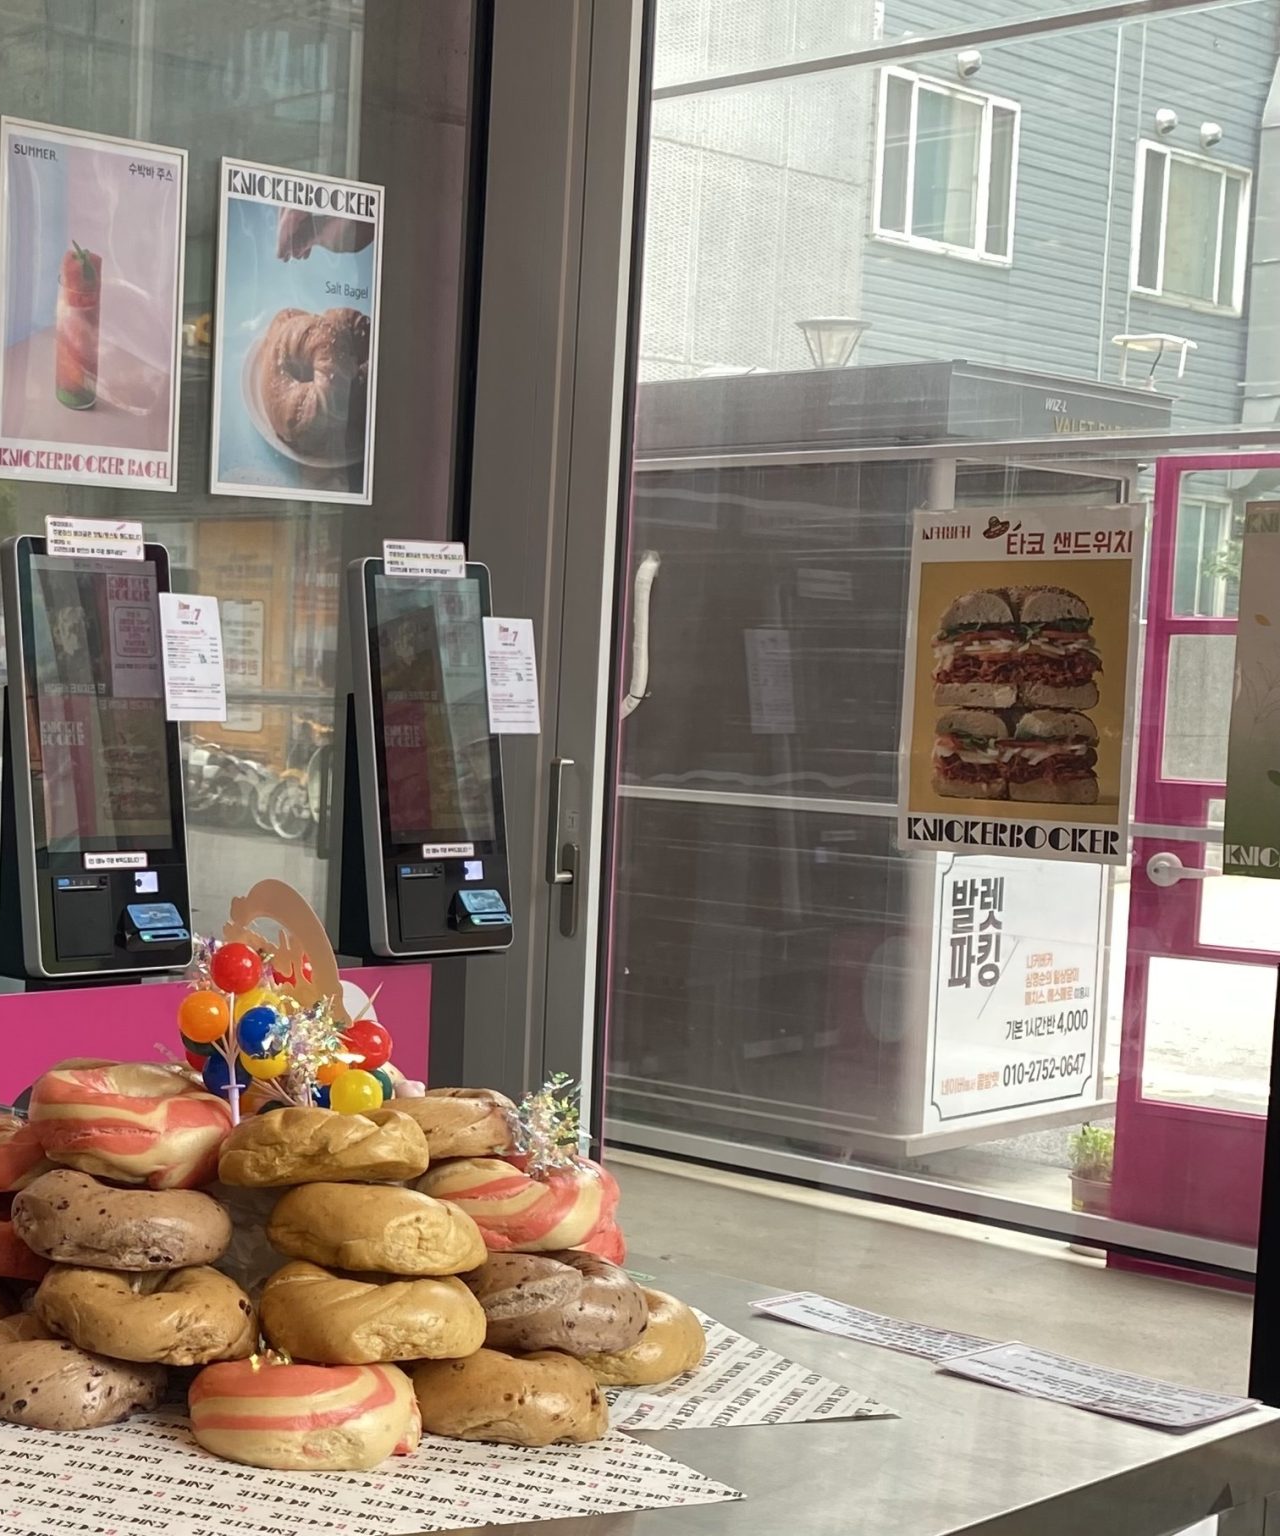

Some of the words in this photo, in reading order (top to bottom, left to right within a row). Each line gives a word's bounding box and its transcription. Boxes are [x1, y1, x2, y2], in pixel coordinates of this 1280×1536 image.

[128, 162, 155, 178] 수박바
[157, 167, 174, 181] 주스
[228, 169, 376, 218] KNICKERBOCKER
[325, 281, 342, 296] Salt
[344, 284, 369, 300] Bagel
[128, 459, 169, 480] BAGEL
[1006, 528, 1045, 555] 타코
[1053, 530, 1133, 554] 샌드위치
[907, 816, 1119, 855] KNICKERBOCKER
[952, 877, 1004, 934] 발렛
[948, 933, 1001, 988] 파킹
[1005, 1019, 1023, 1040] 기본
[1057, 1009, 1089, 1036] 4,000
[1003, 1053, 1086, 1087] 010-2752-0647
